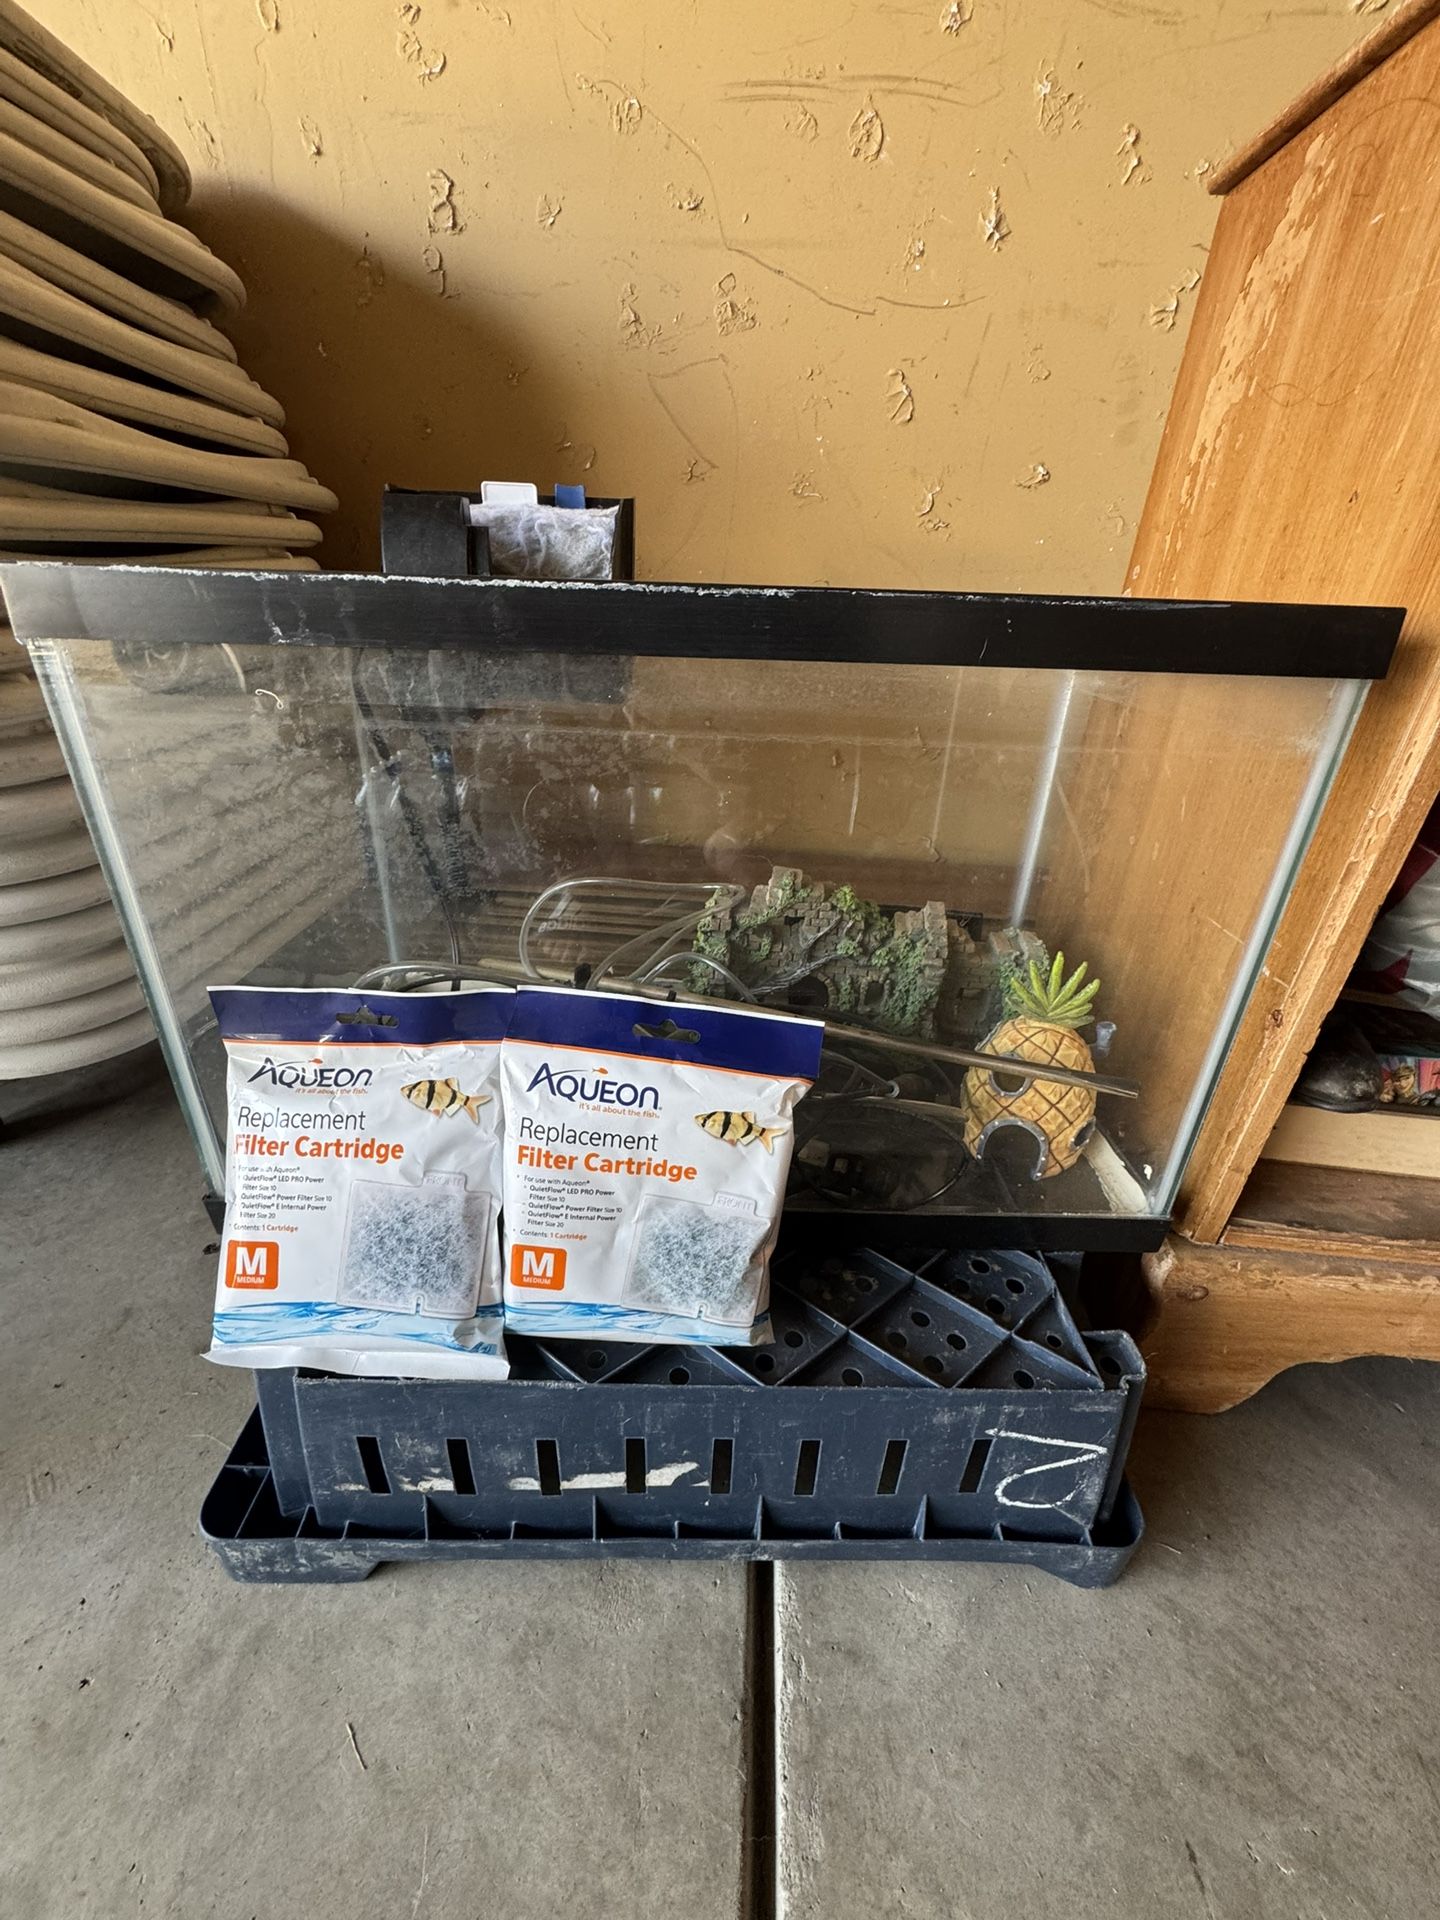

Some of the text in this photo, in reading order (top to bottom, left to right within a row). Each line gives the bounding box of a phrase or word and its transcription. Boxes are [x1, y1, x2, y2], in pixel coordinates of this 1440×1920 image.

[247, 1057, 373, 1088] AQUEON
[526, 1062, 661, 1110] AQUEON
[237, 1105, 366, 1132] Replacement
[579, 1102, 590, 1110] it's
[592, 1104, 600, 1112] all
[602, 1106, 626, 1115] about
[519, 1117, 659, 1152] Replacement
[234, 1134, 404, 1164] Filter Cartridge
[517, 1145, 698, 1182] Filter Cartridge
[266, 1224, 298, 1232] Cartridge
[544, 1220, 556, 1228] Size
[554, 1232, 588, 1240] Cartridge
[236, 1246, 268, 1275] M
[522, 1250, 555, 1278] M
[236, 1276, 264, 1284] MEDIUM
[522, 1276, 551, 1284] MEDIUM
